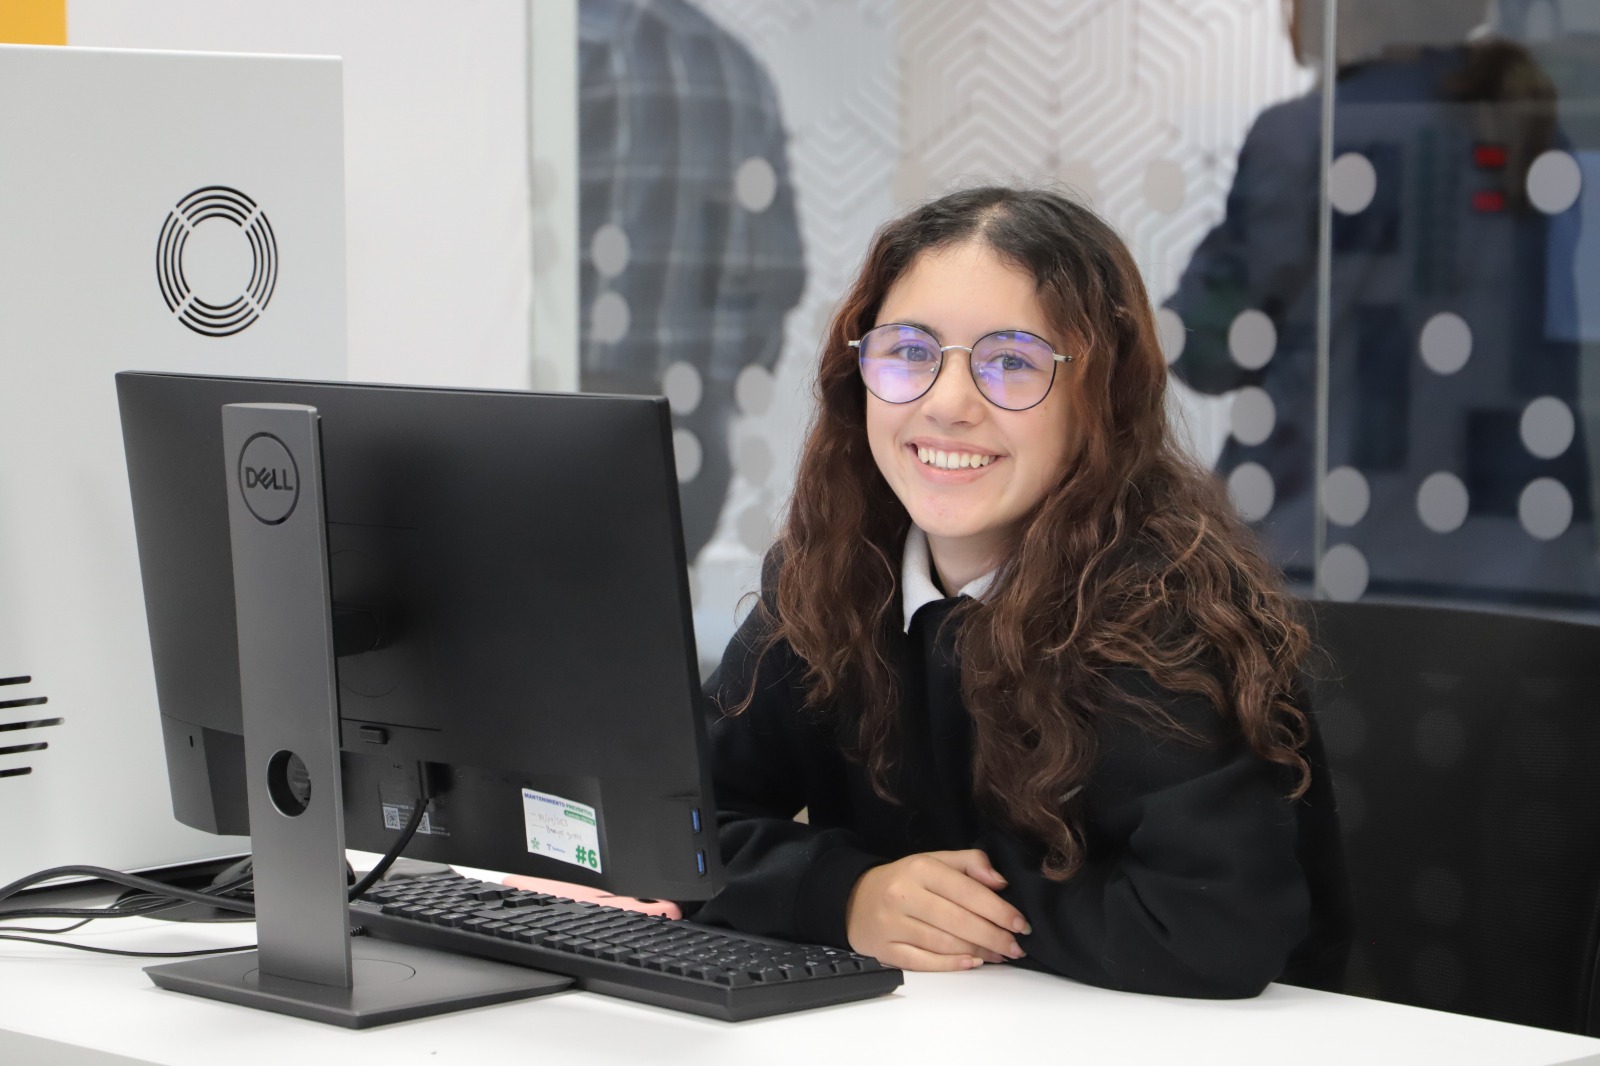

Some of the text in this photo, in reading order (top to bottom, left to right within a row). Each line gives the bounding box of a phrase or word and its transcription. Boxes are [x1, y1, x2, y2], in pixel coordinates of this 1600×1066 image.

[245, 467, 293, 491] DELL
[524, 793, 565, 808] MANTENIMIENTO
[575, 845, 598, 869] #6
